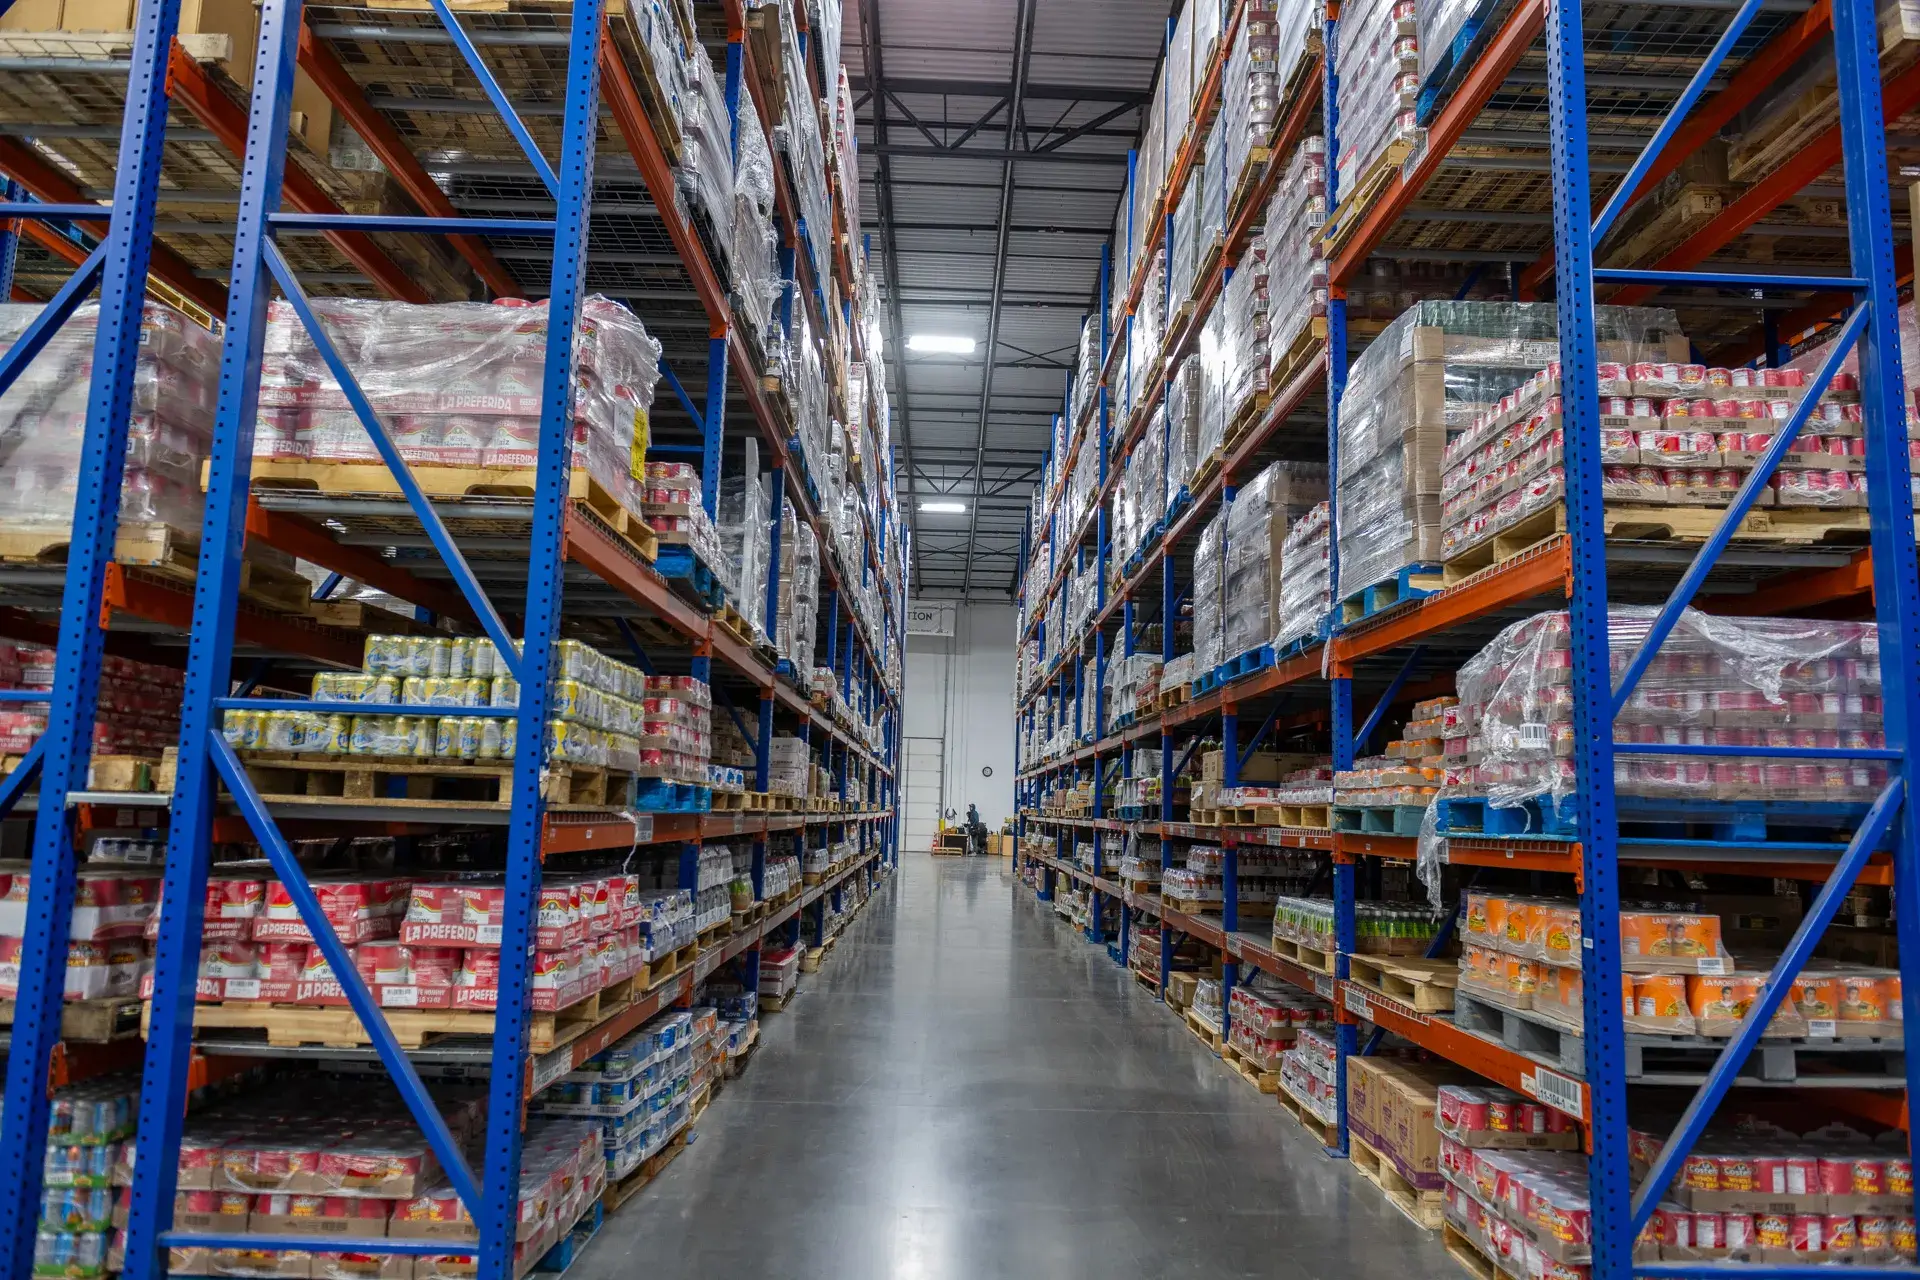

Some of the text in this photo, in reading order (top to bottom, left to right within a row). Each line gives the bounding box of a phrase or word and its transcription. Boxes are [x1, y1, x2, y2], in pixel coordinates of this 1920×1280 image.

[441, 395, 454, 410] LA
[457, 395, 512, 411] PREFERIDA
[487, 454, 497, 464] LA
[907, 611, 933, 621] TION
[256, 924, 267, 938] LA
[405, 924, 476, 943] LA PREFERID
[297, 983, 313, 1000] LA
[457, 989, 499, 1002] LA PREFE
